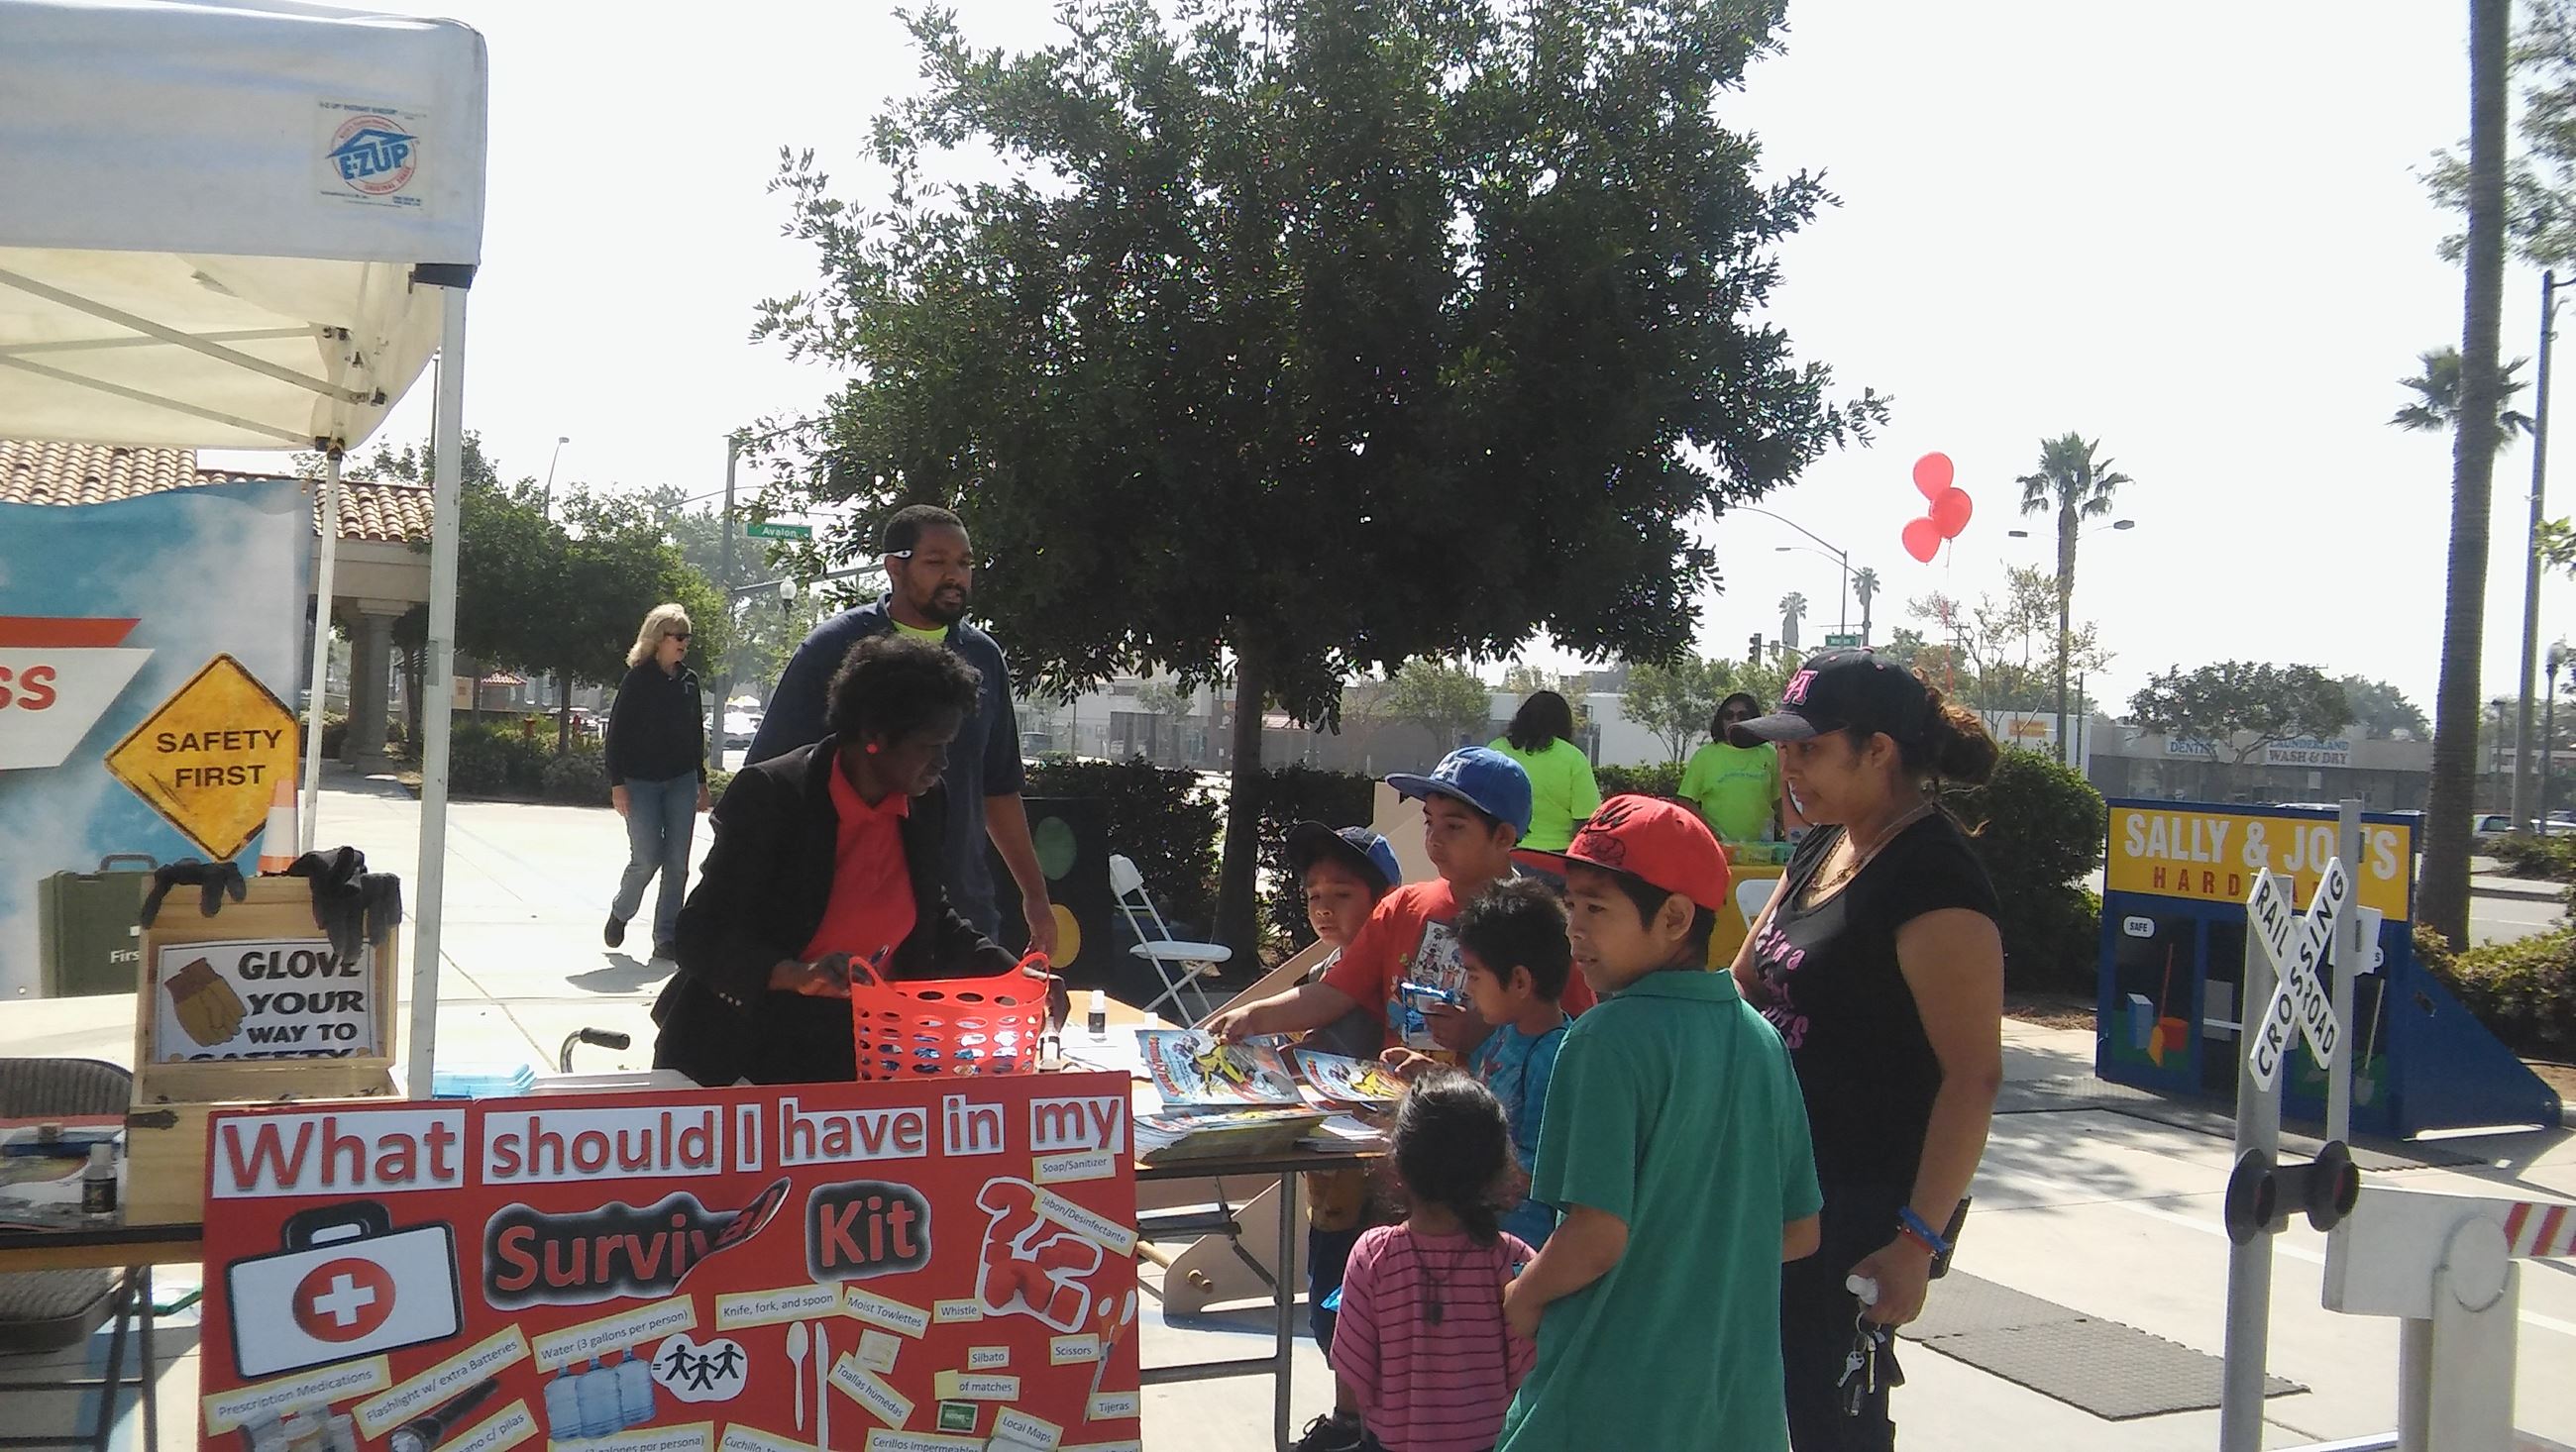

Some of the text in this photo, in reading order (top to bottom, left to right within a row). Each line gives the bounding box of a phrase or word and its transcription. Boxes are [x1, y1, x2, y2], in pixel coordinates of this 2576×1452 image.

[762, 527, 798, 537] Avalon
[157, 729, 283, 753] SAFETY
[2269, 750, 2348, 765] WASH & DRY
[175, 766, 266, 788] FIRST
[2124, 813, 2398, 881] SALLY & JO'S
[2129, 921, 2148, 932] SAFE
[2255, 881, 2289, 958] RAIL
[110, 949, 140, 964] Firs
[2259, 870, 2344, 1077] CROSSING
[247, 990, 365, 1016] YOUR
[247, 1022, 358, 1044] WAY TO
[222, 1097, 1120, 1190] What should I have in my
[1042, 1157, 1107, 1173] Soap/Sanitizer
[820, 1195, 916, 1267] Kit
[723, 1295, 833, 1317] Knife, fork, and spoon
[847, 1296, 921, 1328] Moist Towlettes
[941, 1305, 977, 1316] Whistle
[541, 1309, 689, 1360] Water (3 gallons per person)
[972, 1351, 1006, 1364] Silbato
[1055, 1345, 1092, 1356] Scissors
[366, 1340, 518, 1422] Flashlight w/ extra Batteries
[837, 1364, 866, 1391] Toallas
[959, 1381, 1013, 1392] of matches
[218, 1370, 374, 1417] Prescription Medications
[1099, 1401, 1129, 1414] Tijeras
[499, 1413, 525, 1435] pilas
[1003, 1416, 1052, 1443] Local Maps
[660, 1435, 704, 1451] persona)
[873, 1436, 909, 1450] Cerillos
